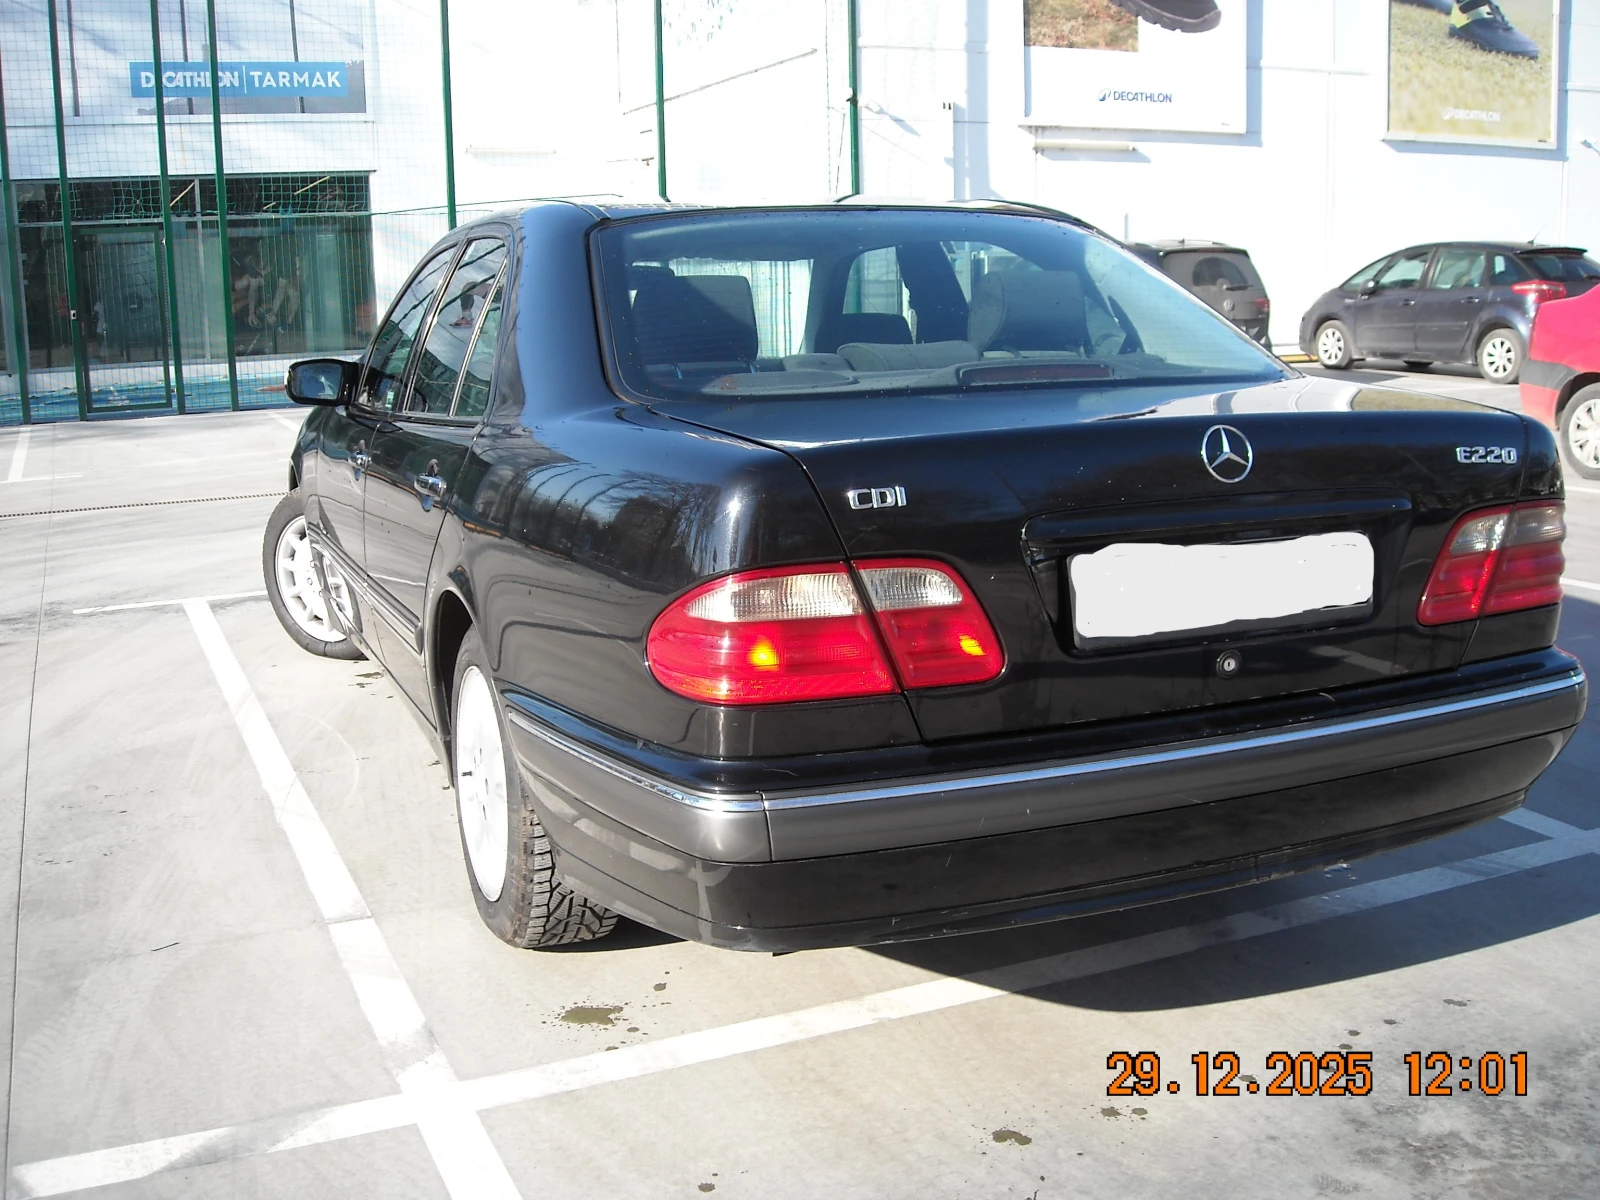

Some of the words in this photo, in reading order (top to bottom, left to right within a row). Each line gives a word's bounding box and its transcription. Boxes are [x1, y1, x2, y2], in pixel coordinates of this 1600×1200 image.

[140, 71, 240, 88] DCATHLON
[250, 71, 342, 88] TARMAK
[1113, 90, 1173, 103] DECATHLON
[1455, 446, 1518, 464] E220
[847, 484, 907, 510] CDI
